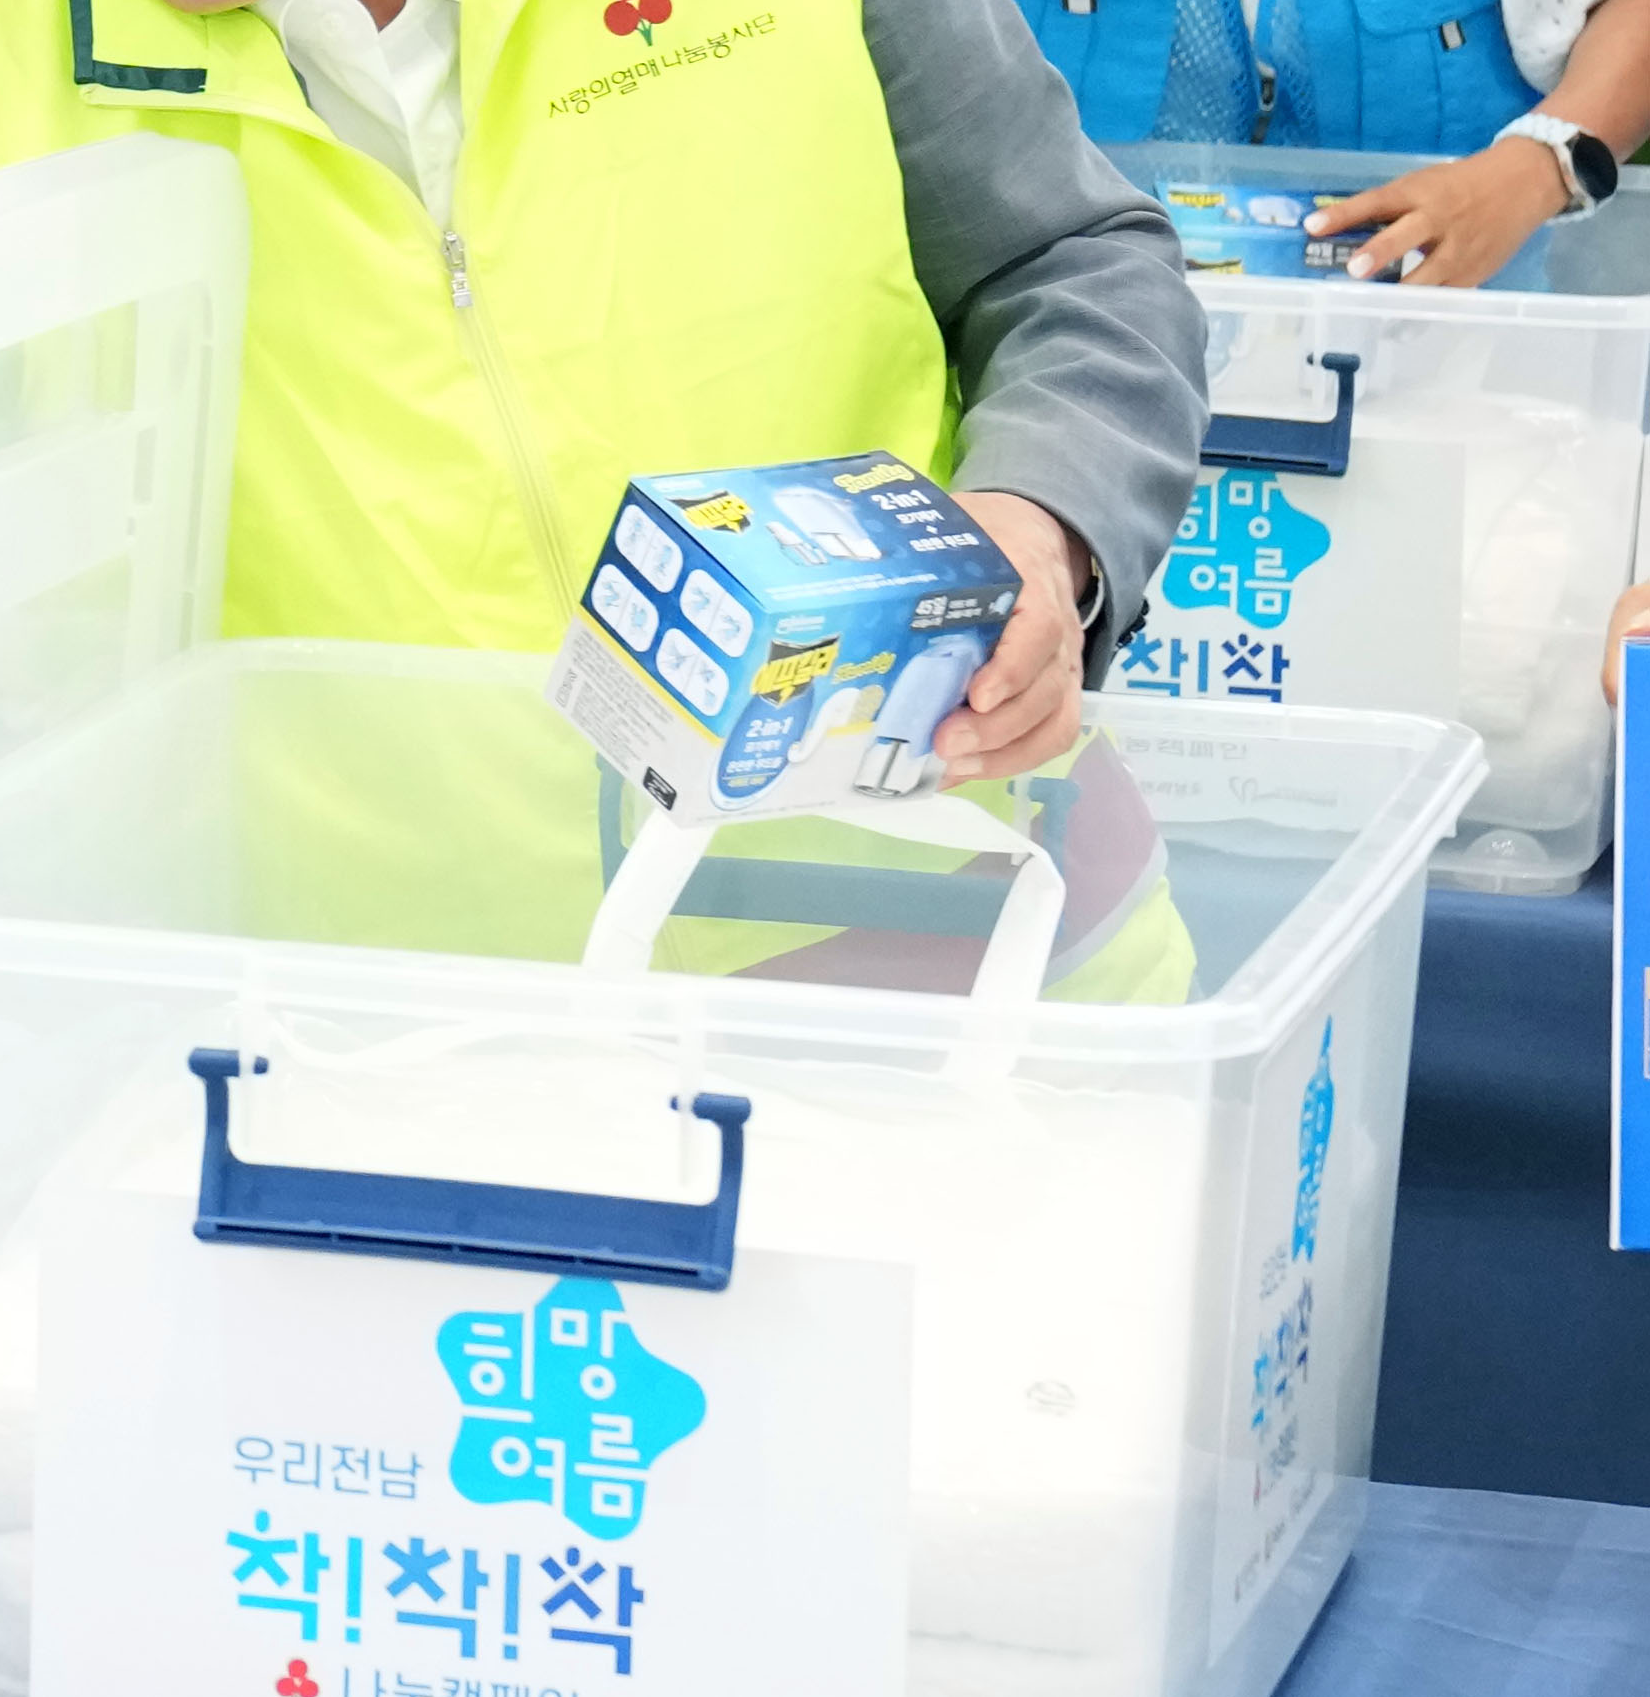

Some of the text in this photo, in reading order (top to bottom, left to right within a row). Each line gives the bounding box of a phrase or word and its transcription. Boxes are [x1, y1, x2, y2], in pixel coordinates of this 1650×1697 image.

[1189, 547, 1294, 615] 여름
[461, 1306, 628, 1425] 희망
[233, 1434, 425, 1501] 우리전남
[491, 1412, 650, 1520] 여름
[225, 1509, 645, 1676] 착!착!착
